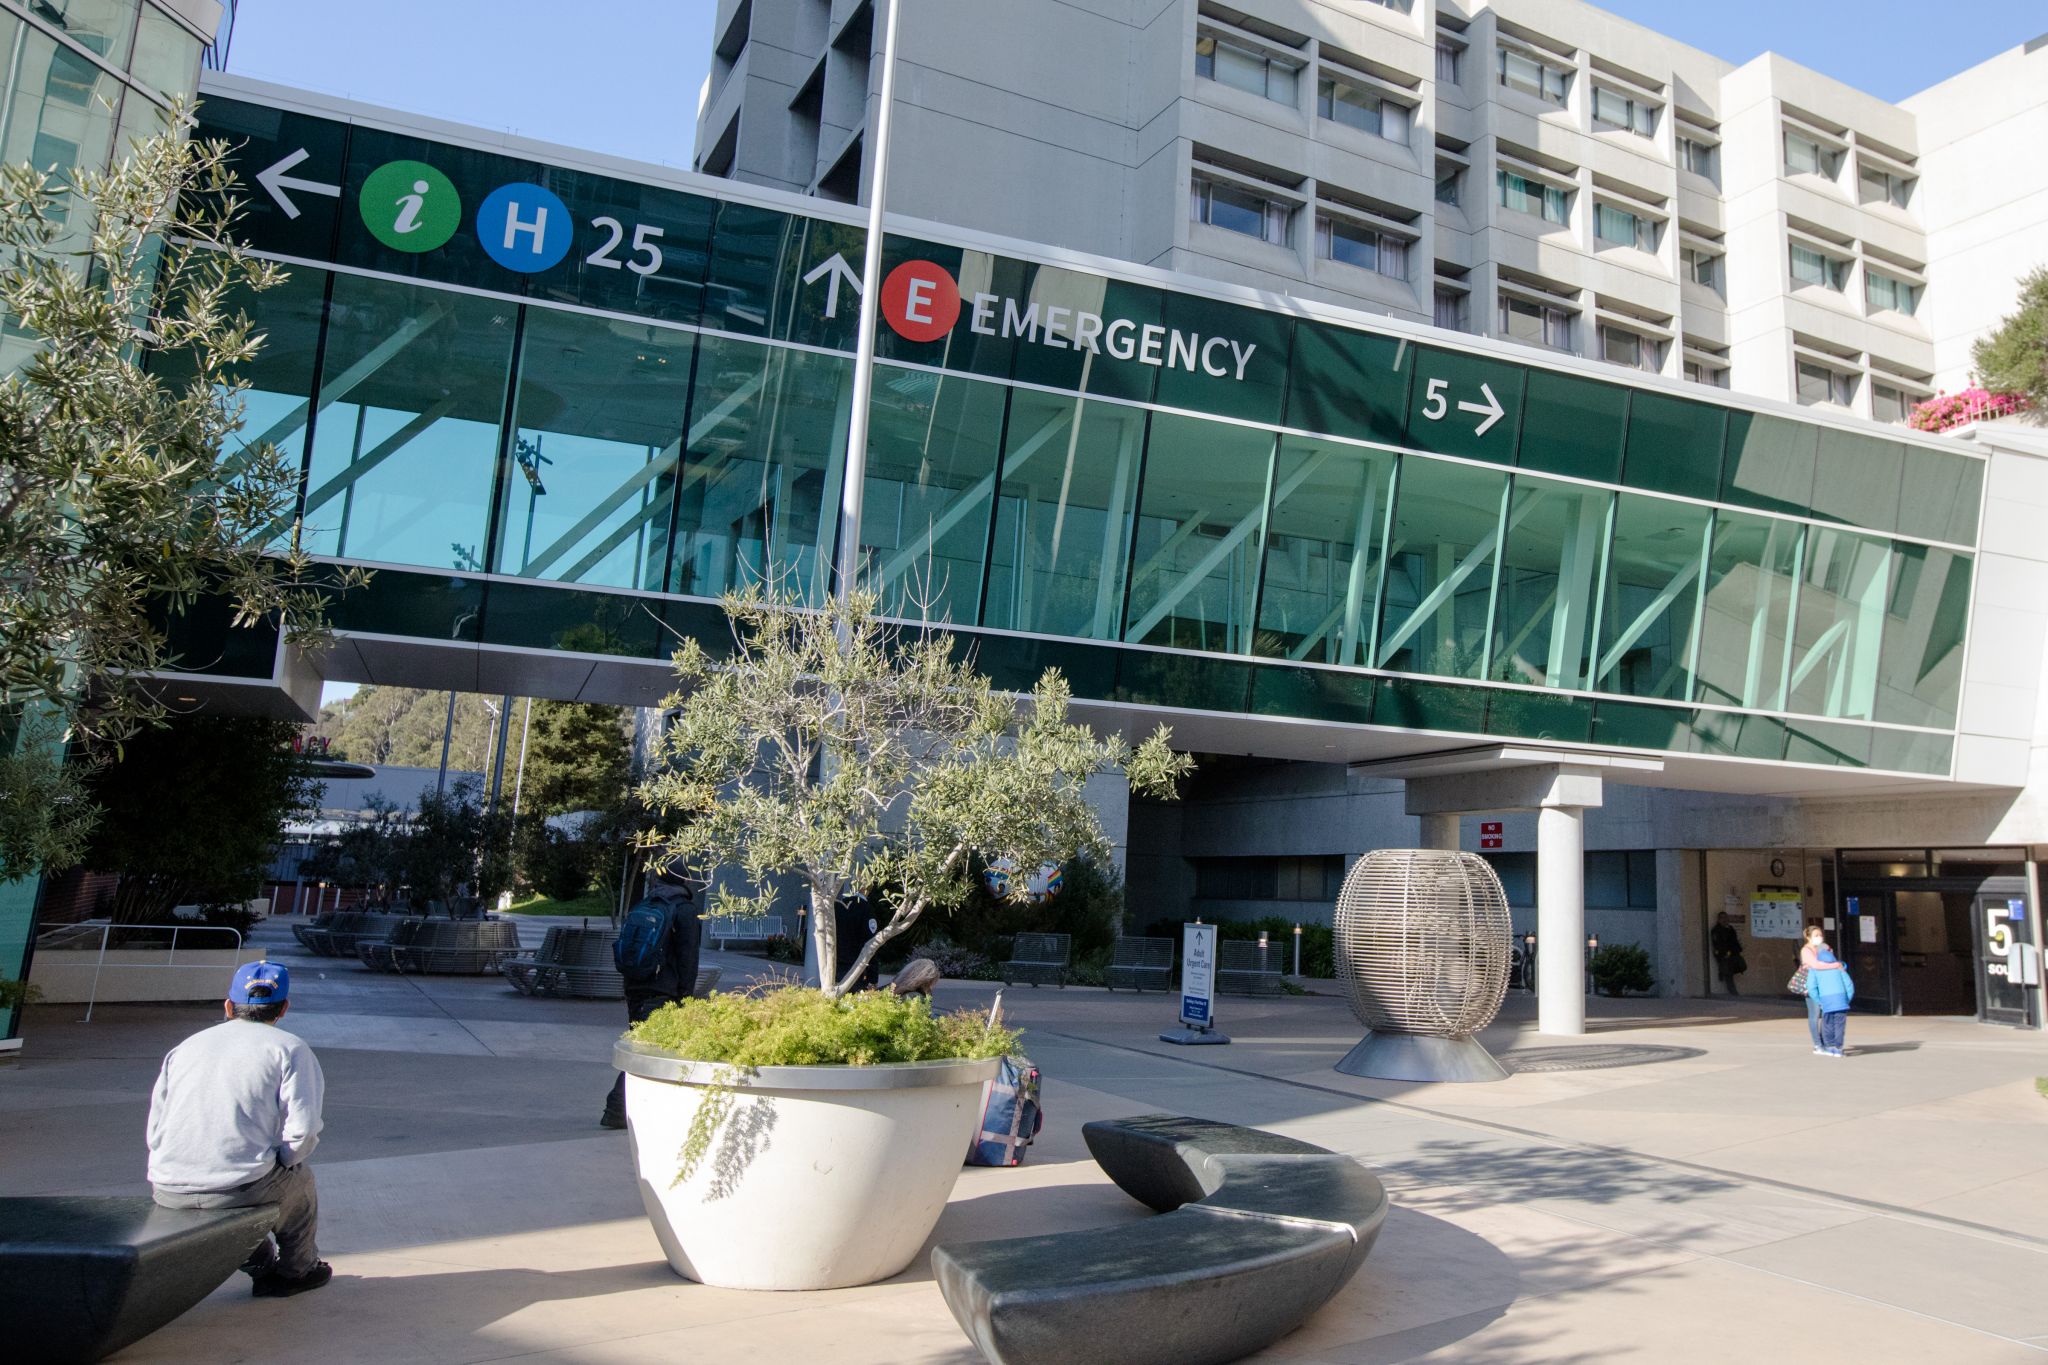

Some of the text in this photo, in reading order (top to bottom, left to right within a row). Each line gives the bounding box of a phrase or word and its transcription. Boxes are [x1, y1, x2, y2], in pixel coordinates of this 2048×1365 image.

[503, 201, 548, 254] H
[586, 216, 665, 275] 25
[905, 277, 1256, 381] E EMERGENCY
[1422, 377, 1449, 420] 5
[1193, 948, 1205, 958] Adult
[1987, 908, 2013, 956] 5
[1186, 957, 1201, 969] Urgent
